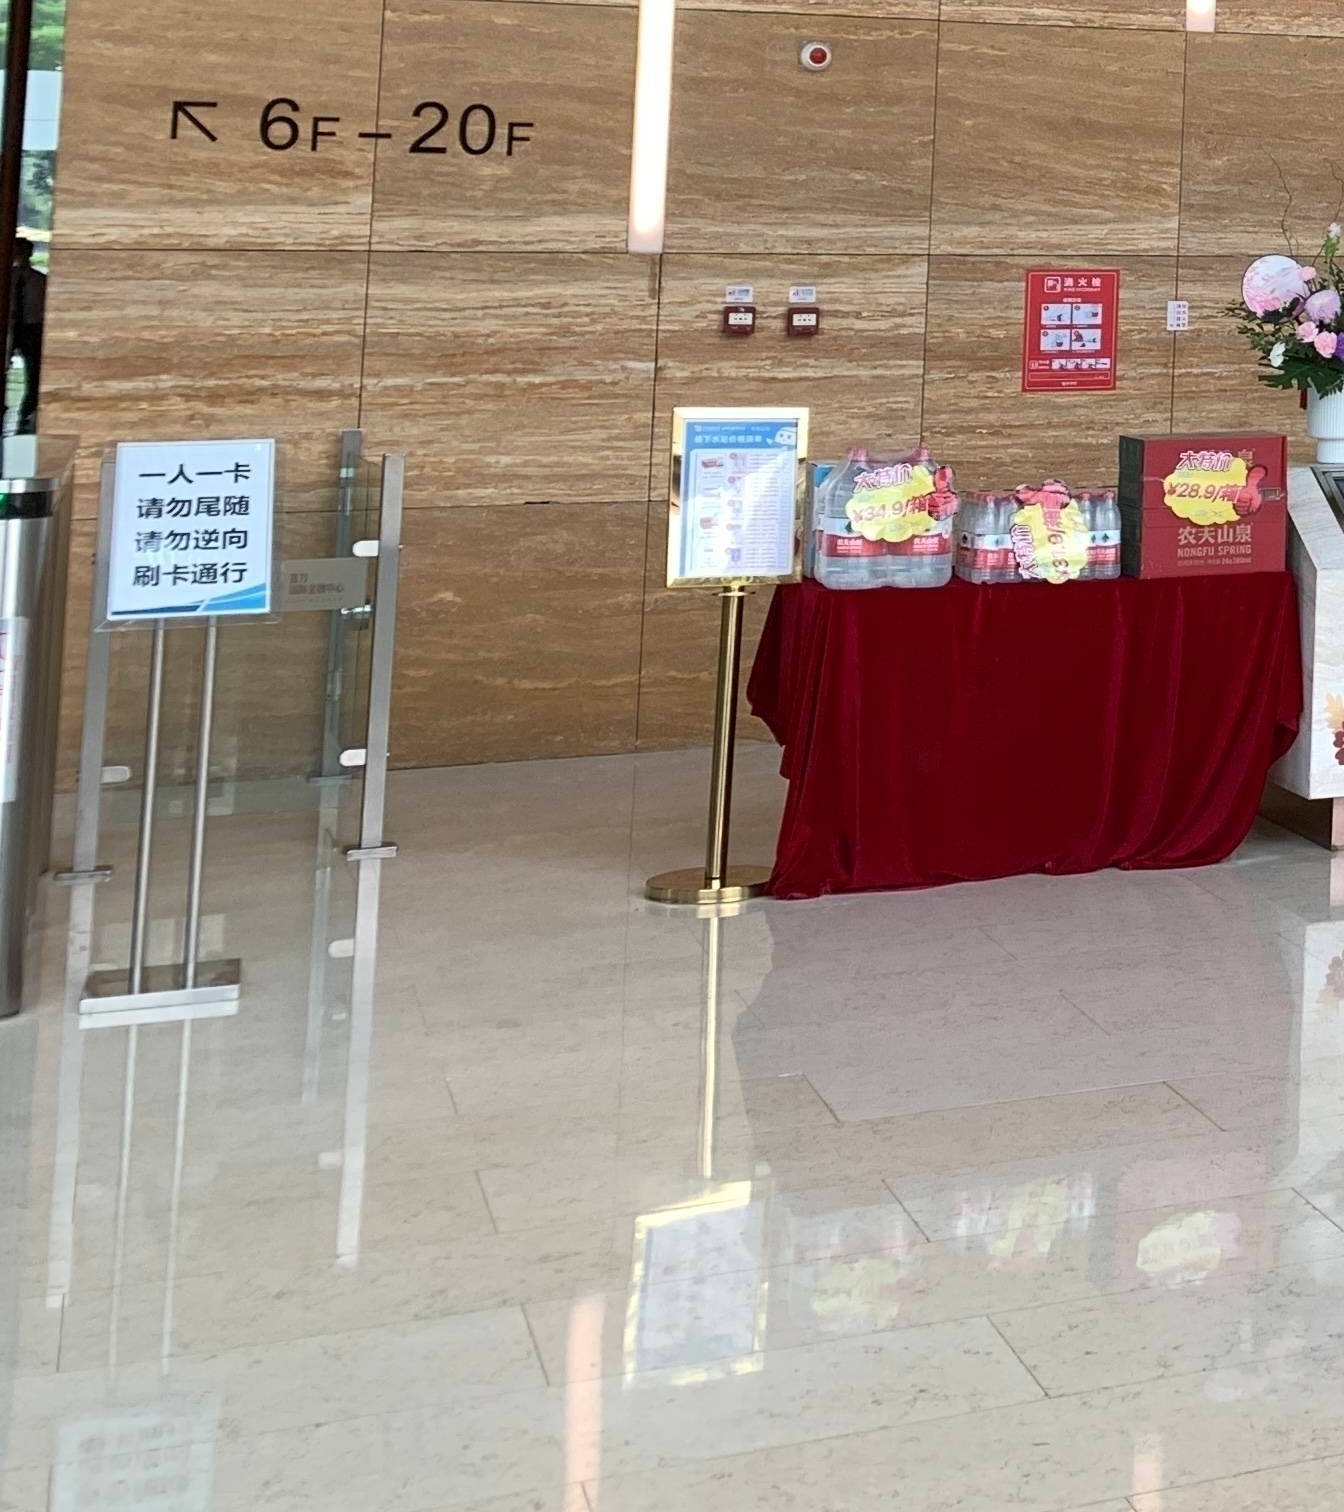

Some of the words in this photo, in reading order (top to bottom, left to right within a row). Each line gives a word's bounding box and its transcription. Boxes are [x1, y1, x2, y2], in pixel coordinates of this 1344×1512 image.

[138, 461, 252, 485] 一人一卡
[136, 494, 251, 519] 请勿尾随
[134, 527, 248, 553] 请勿逆向
[1177, 523, 1253, 546] 农夫山泉
[1177, 546, 1215, 558] NONGFU
[1217, 544, 1252, 555] SPRING
[132, 561, 248, 587] 刷卡通行
